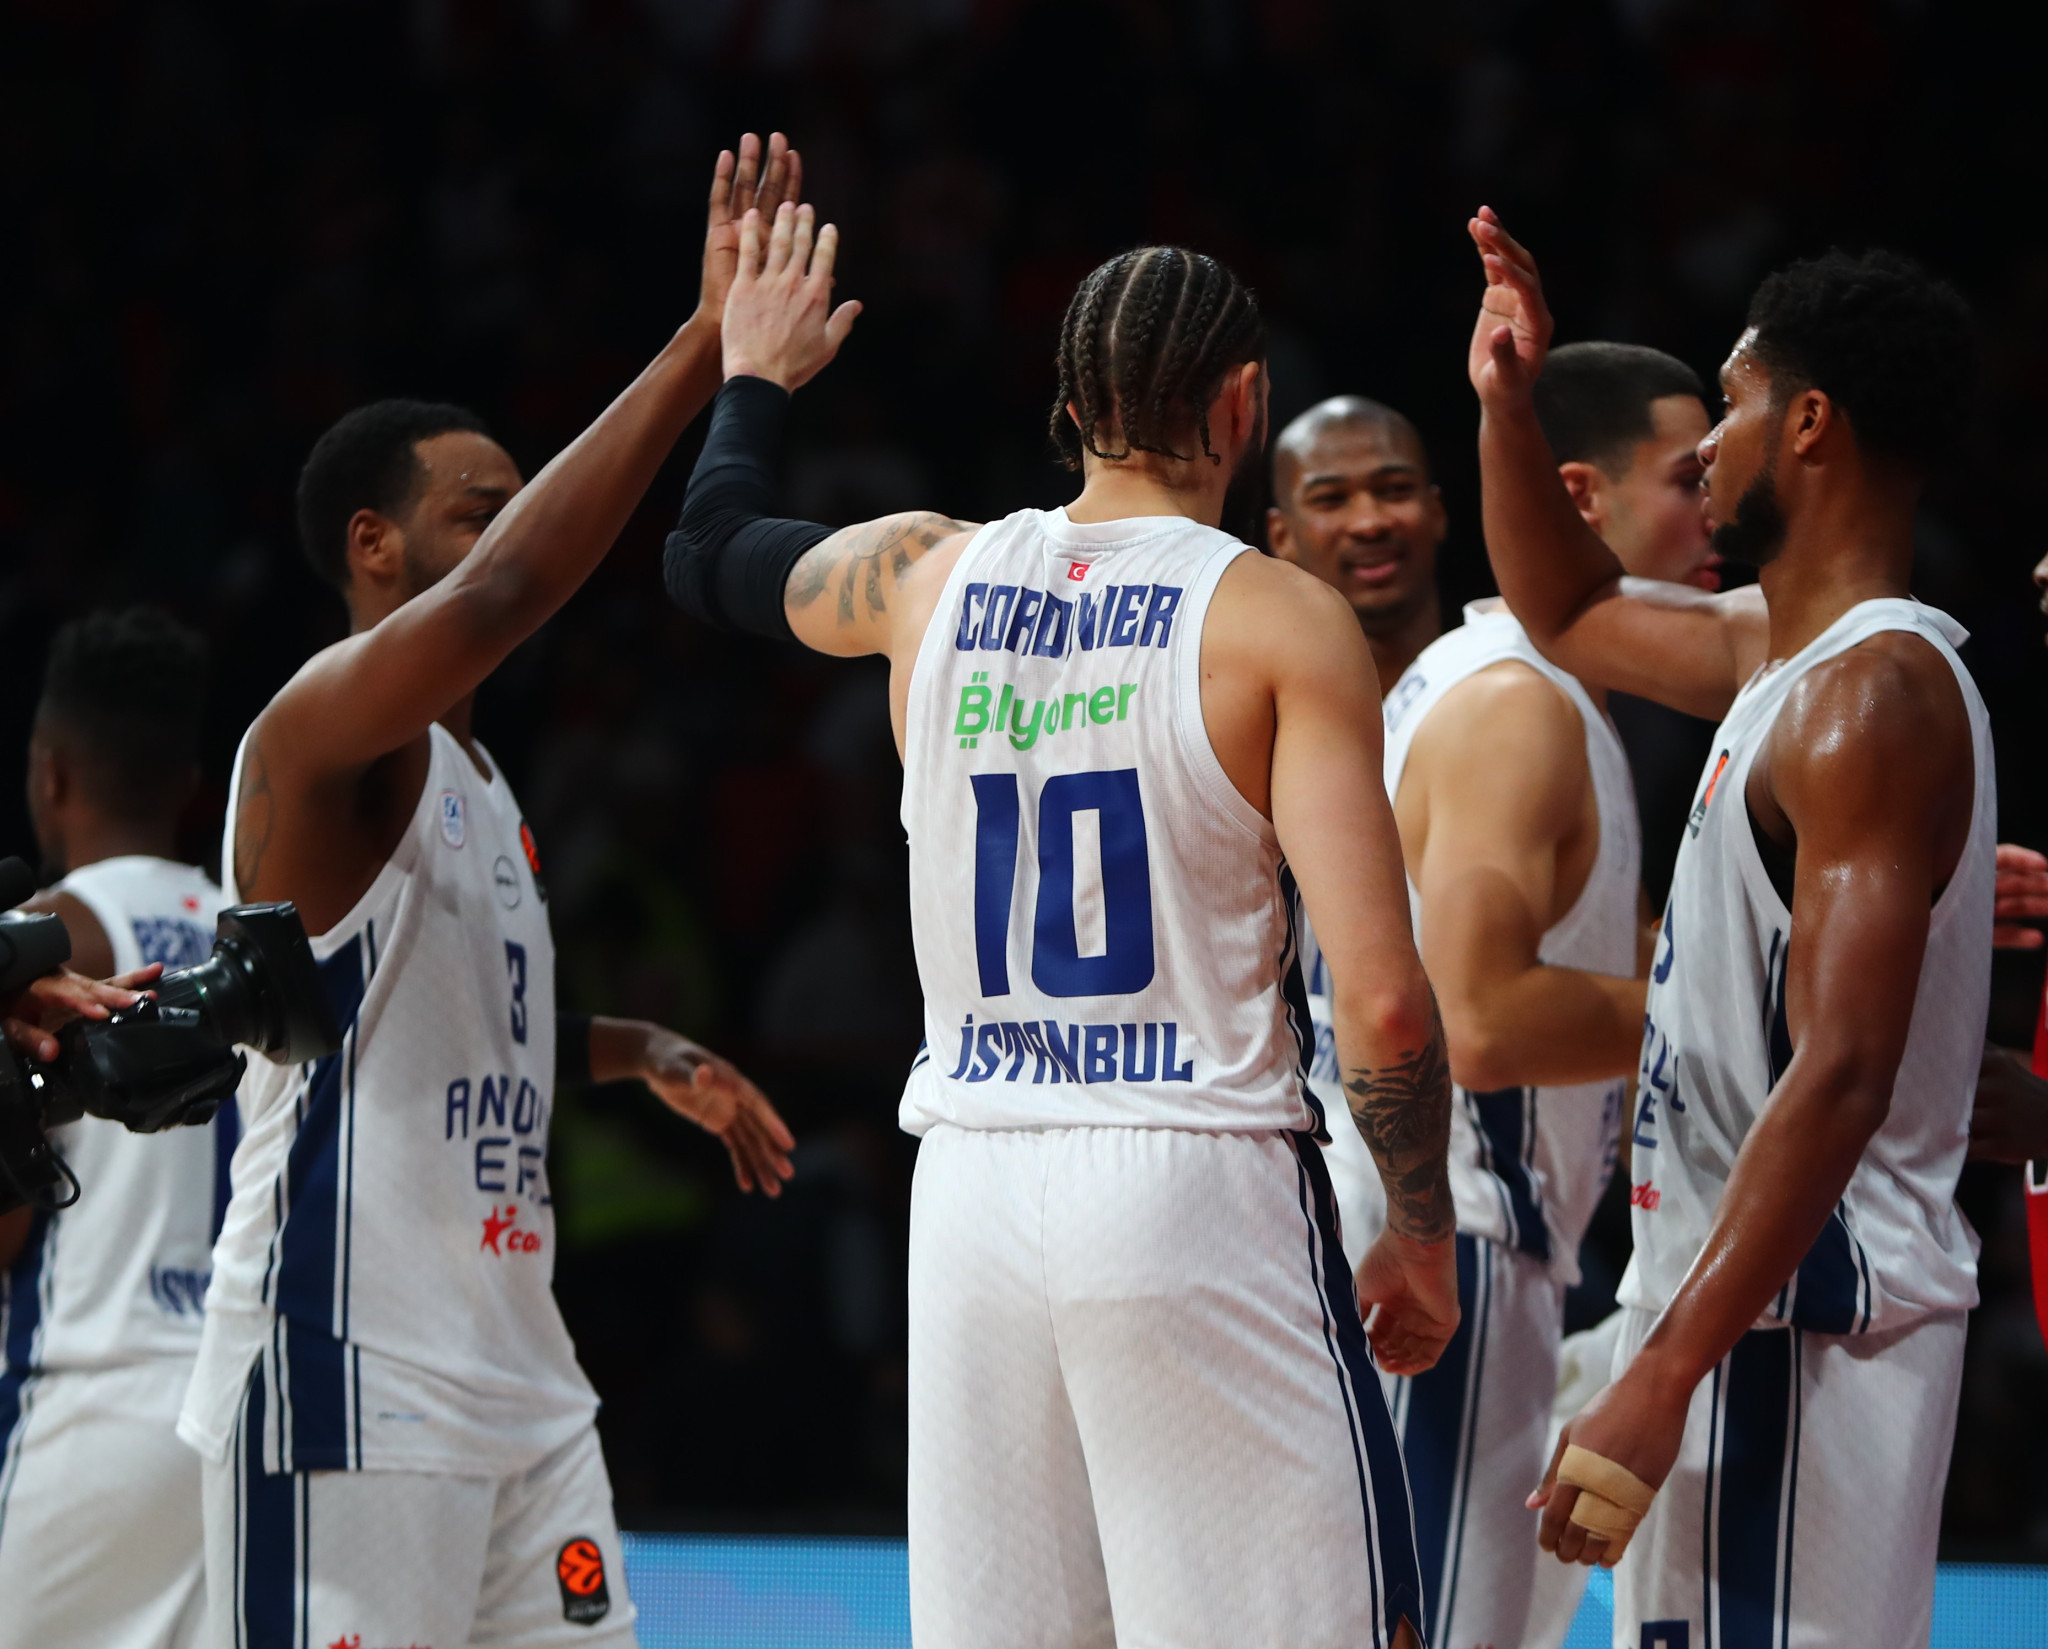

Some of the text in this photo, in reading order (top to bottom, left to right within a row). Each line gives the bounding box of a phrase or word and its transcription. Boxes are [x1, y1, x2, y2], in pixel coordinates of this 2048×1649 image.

[954, 671, 1138, 751] Blyoner
[970, 768, 1156, 998] 10
[505, 938, 527, 1045] 3
